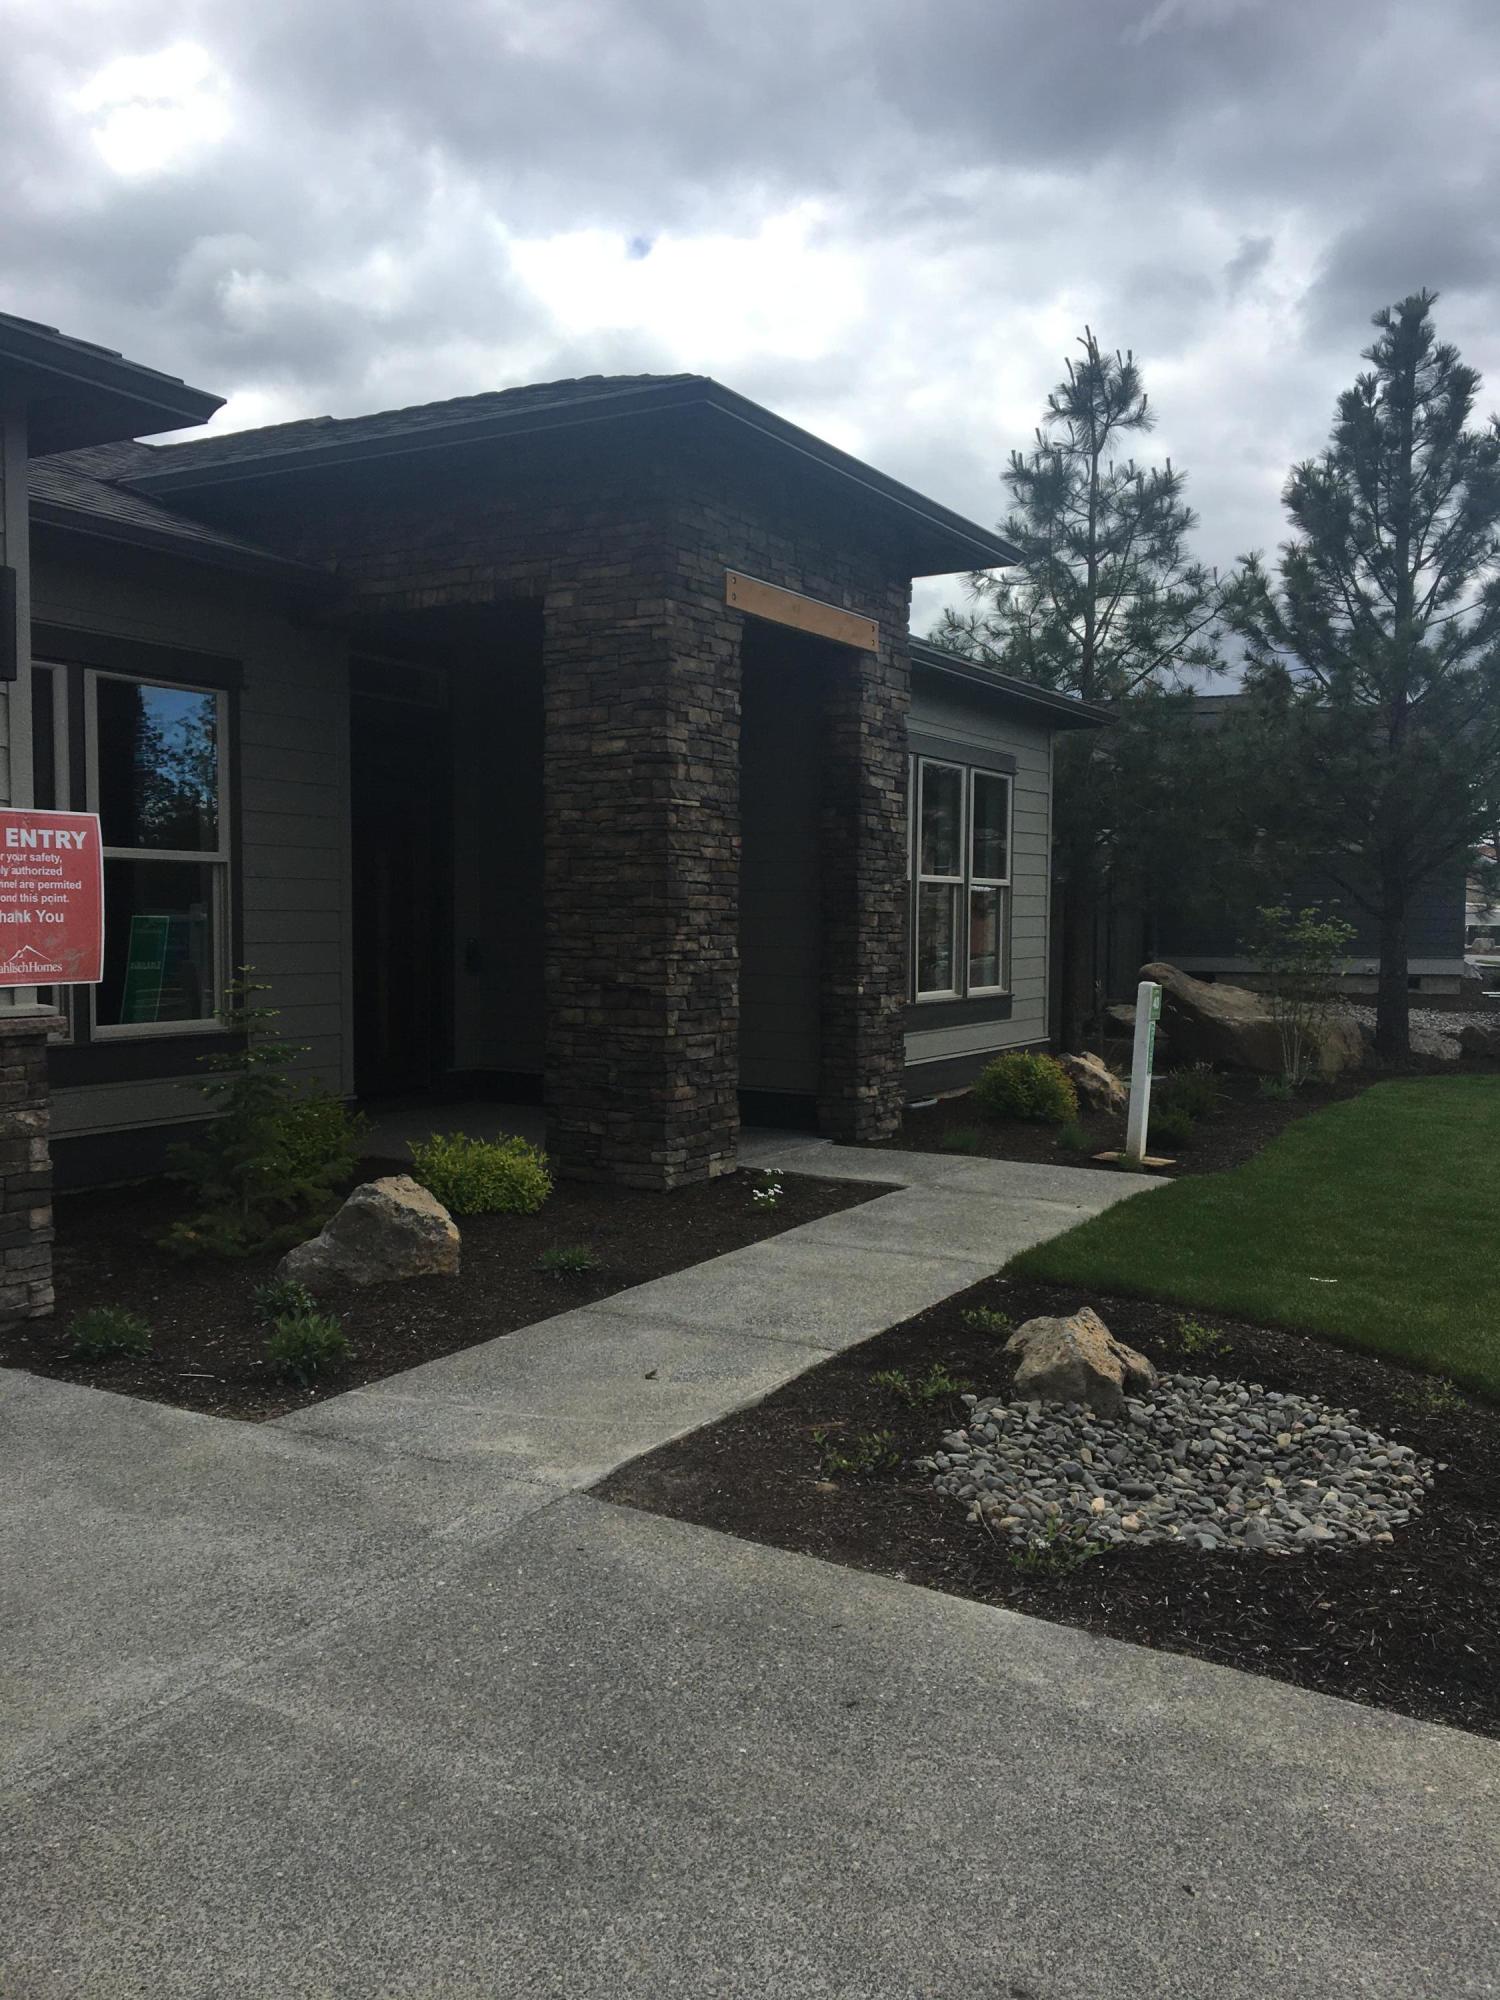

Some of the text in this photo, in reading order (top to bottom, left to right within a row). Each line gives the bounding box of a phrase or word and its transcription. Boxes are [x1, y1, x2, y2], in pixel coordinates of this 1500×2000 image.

[5, 828, 88, 849] ENTRY
[6, 853, 27, 863] your
[29, 852, 63, 864] safety,
[11, 866, 63, 876] authorized
[19, 881, 35, 889] are
[19, 893, 38, 903] this
[41, 894, 70, 904] point.
[0, 909, 65, 923] hank You
